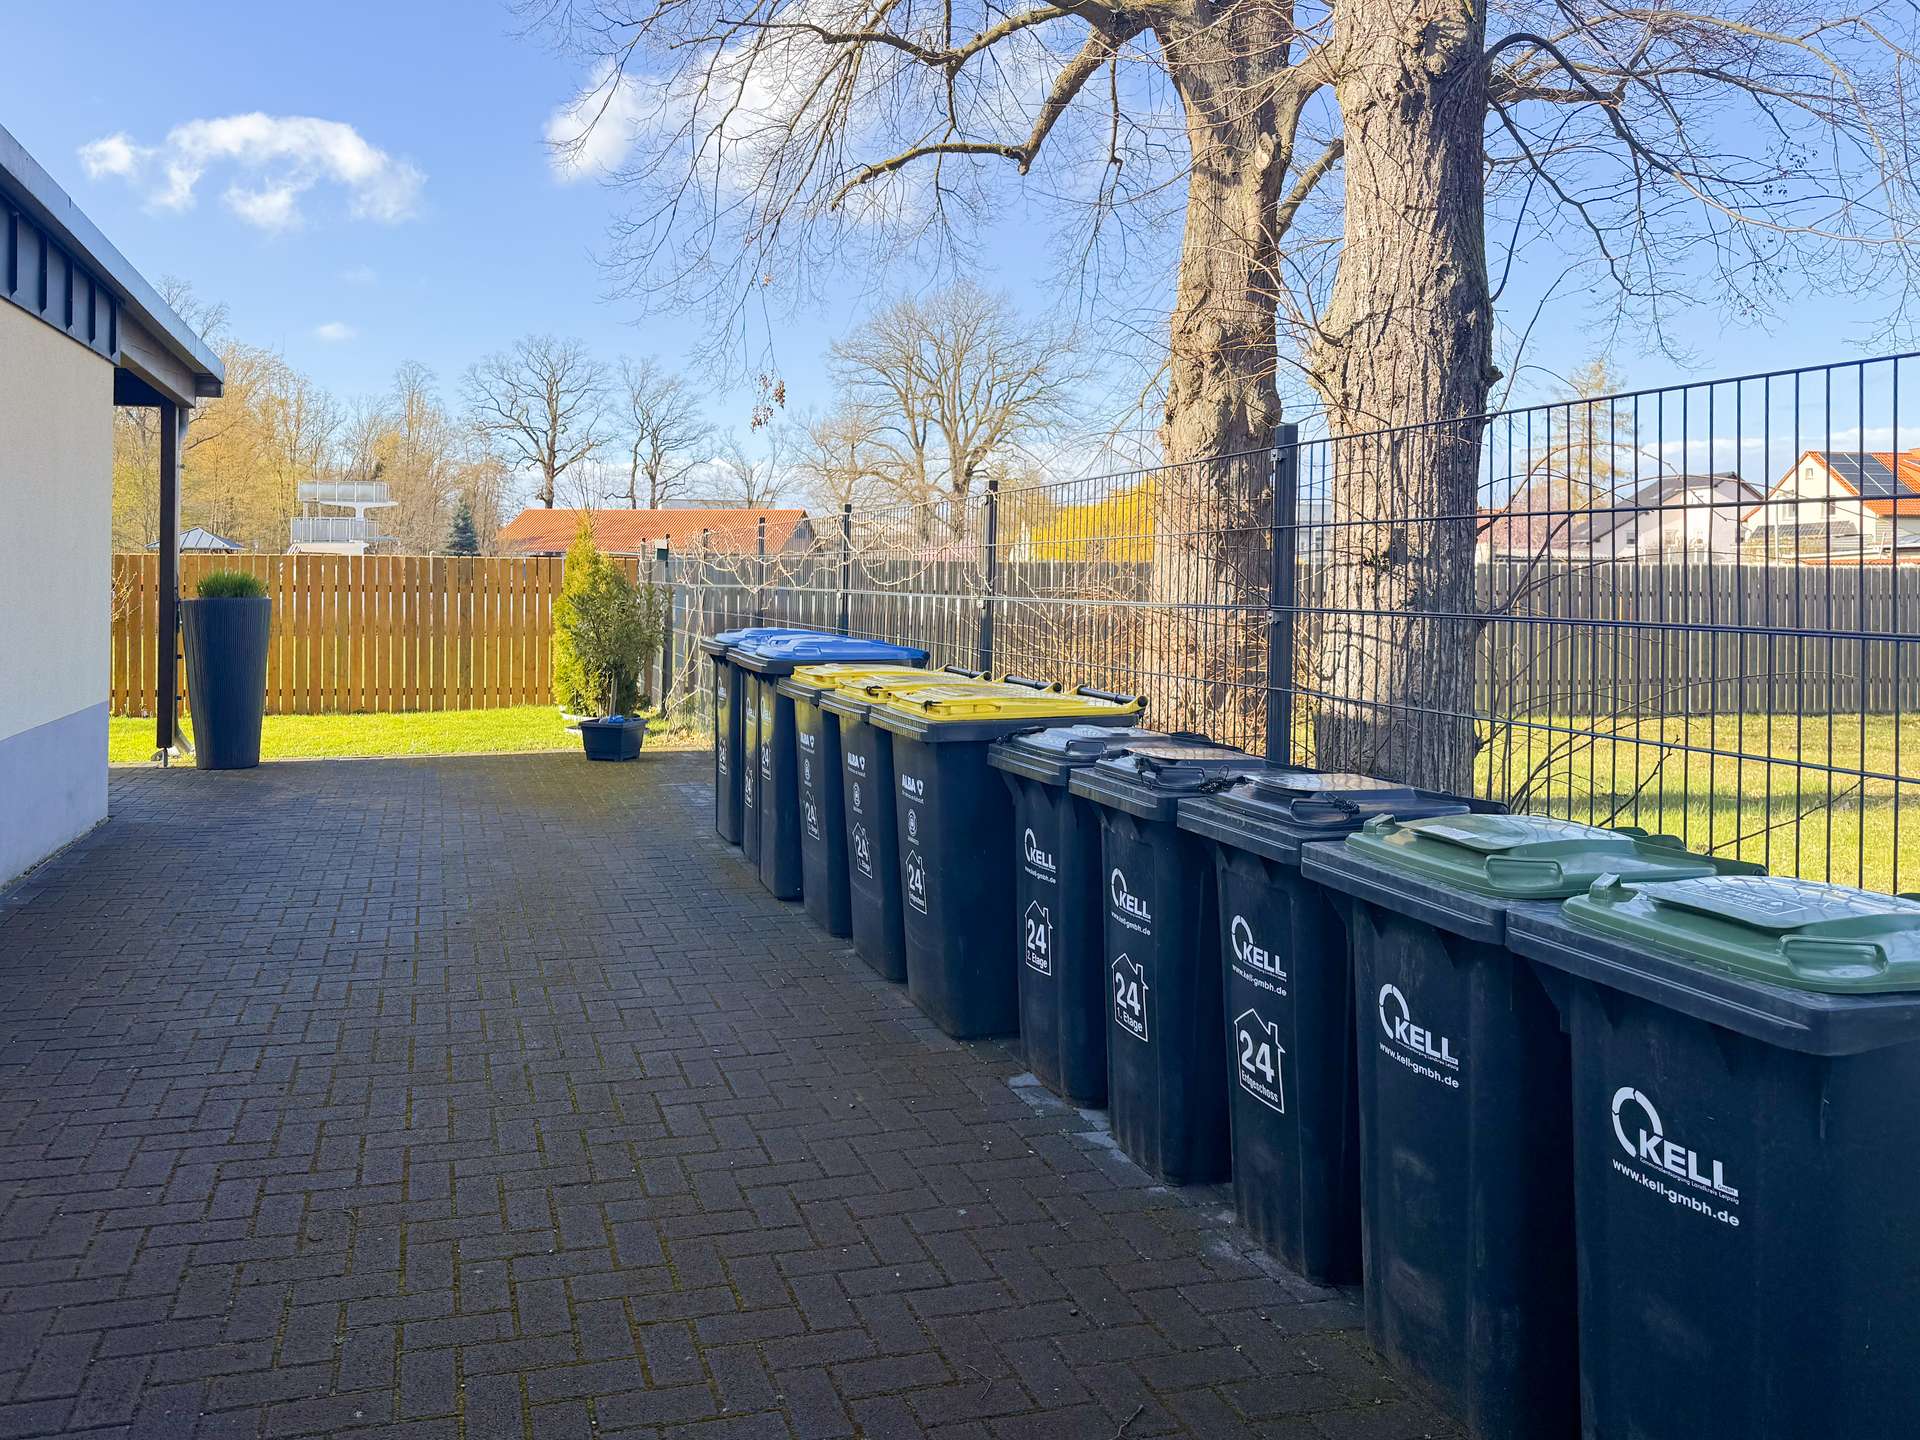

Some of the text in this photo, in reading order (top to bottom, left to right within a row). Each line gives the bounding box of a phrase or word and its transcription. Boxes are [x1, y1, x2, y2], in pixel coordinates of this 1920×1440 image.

[761, 746, 770, 767] 24
[902, 773, 916, 794] ALBA
[804, 801, 817, 825] 24
[856, 834, 869, 862] 24
[1030, 846, 1056, 870] KELL
[909, 863, 923, 894] 24
[1119, 889, 1151, 920] KELL
[1027, 918, 1047, 954] 24
[1032, 952, 1048, 968] Etage
[1243, 940, 1287, 978] KELL
[1115, 971, 1141, 1016] 24
[1232, 964, 1287, 996] www.kell-gmbh.de
[1116, 1006, 1143, 1032] 1. Etage
[1395, 1015, 1458, 1066] KELL
[1239, 1029, 1275, 1084] 24
[1379, 1041, 1460, 1088] www.kell-gmbh.de
[1241, 1069, 1279, 1103] Erdgeschoss
[1639, 1127, 1739, 1197] KELL
[1612, 1158, 1740, 1227] www.kell-gmbh.de
[1718, 1189, 1740, 1205] Leipzig
